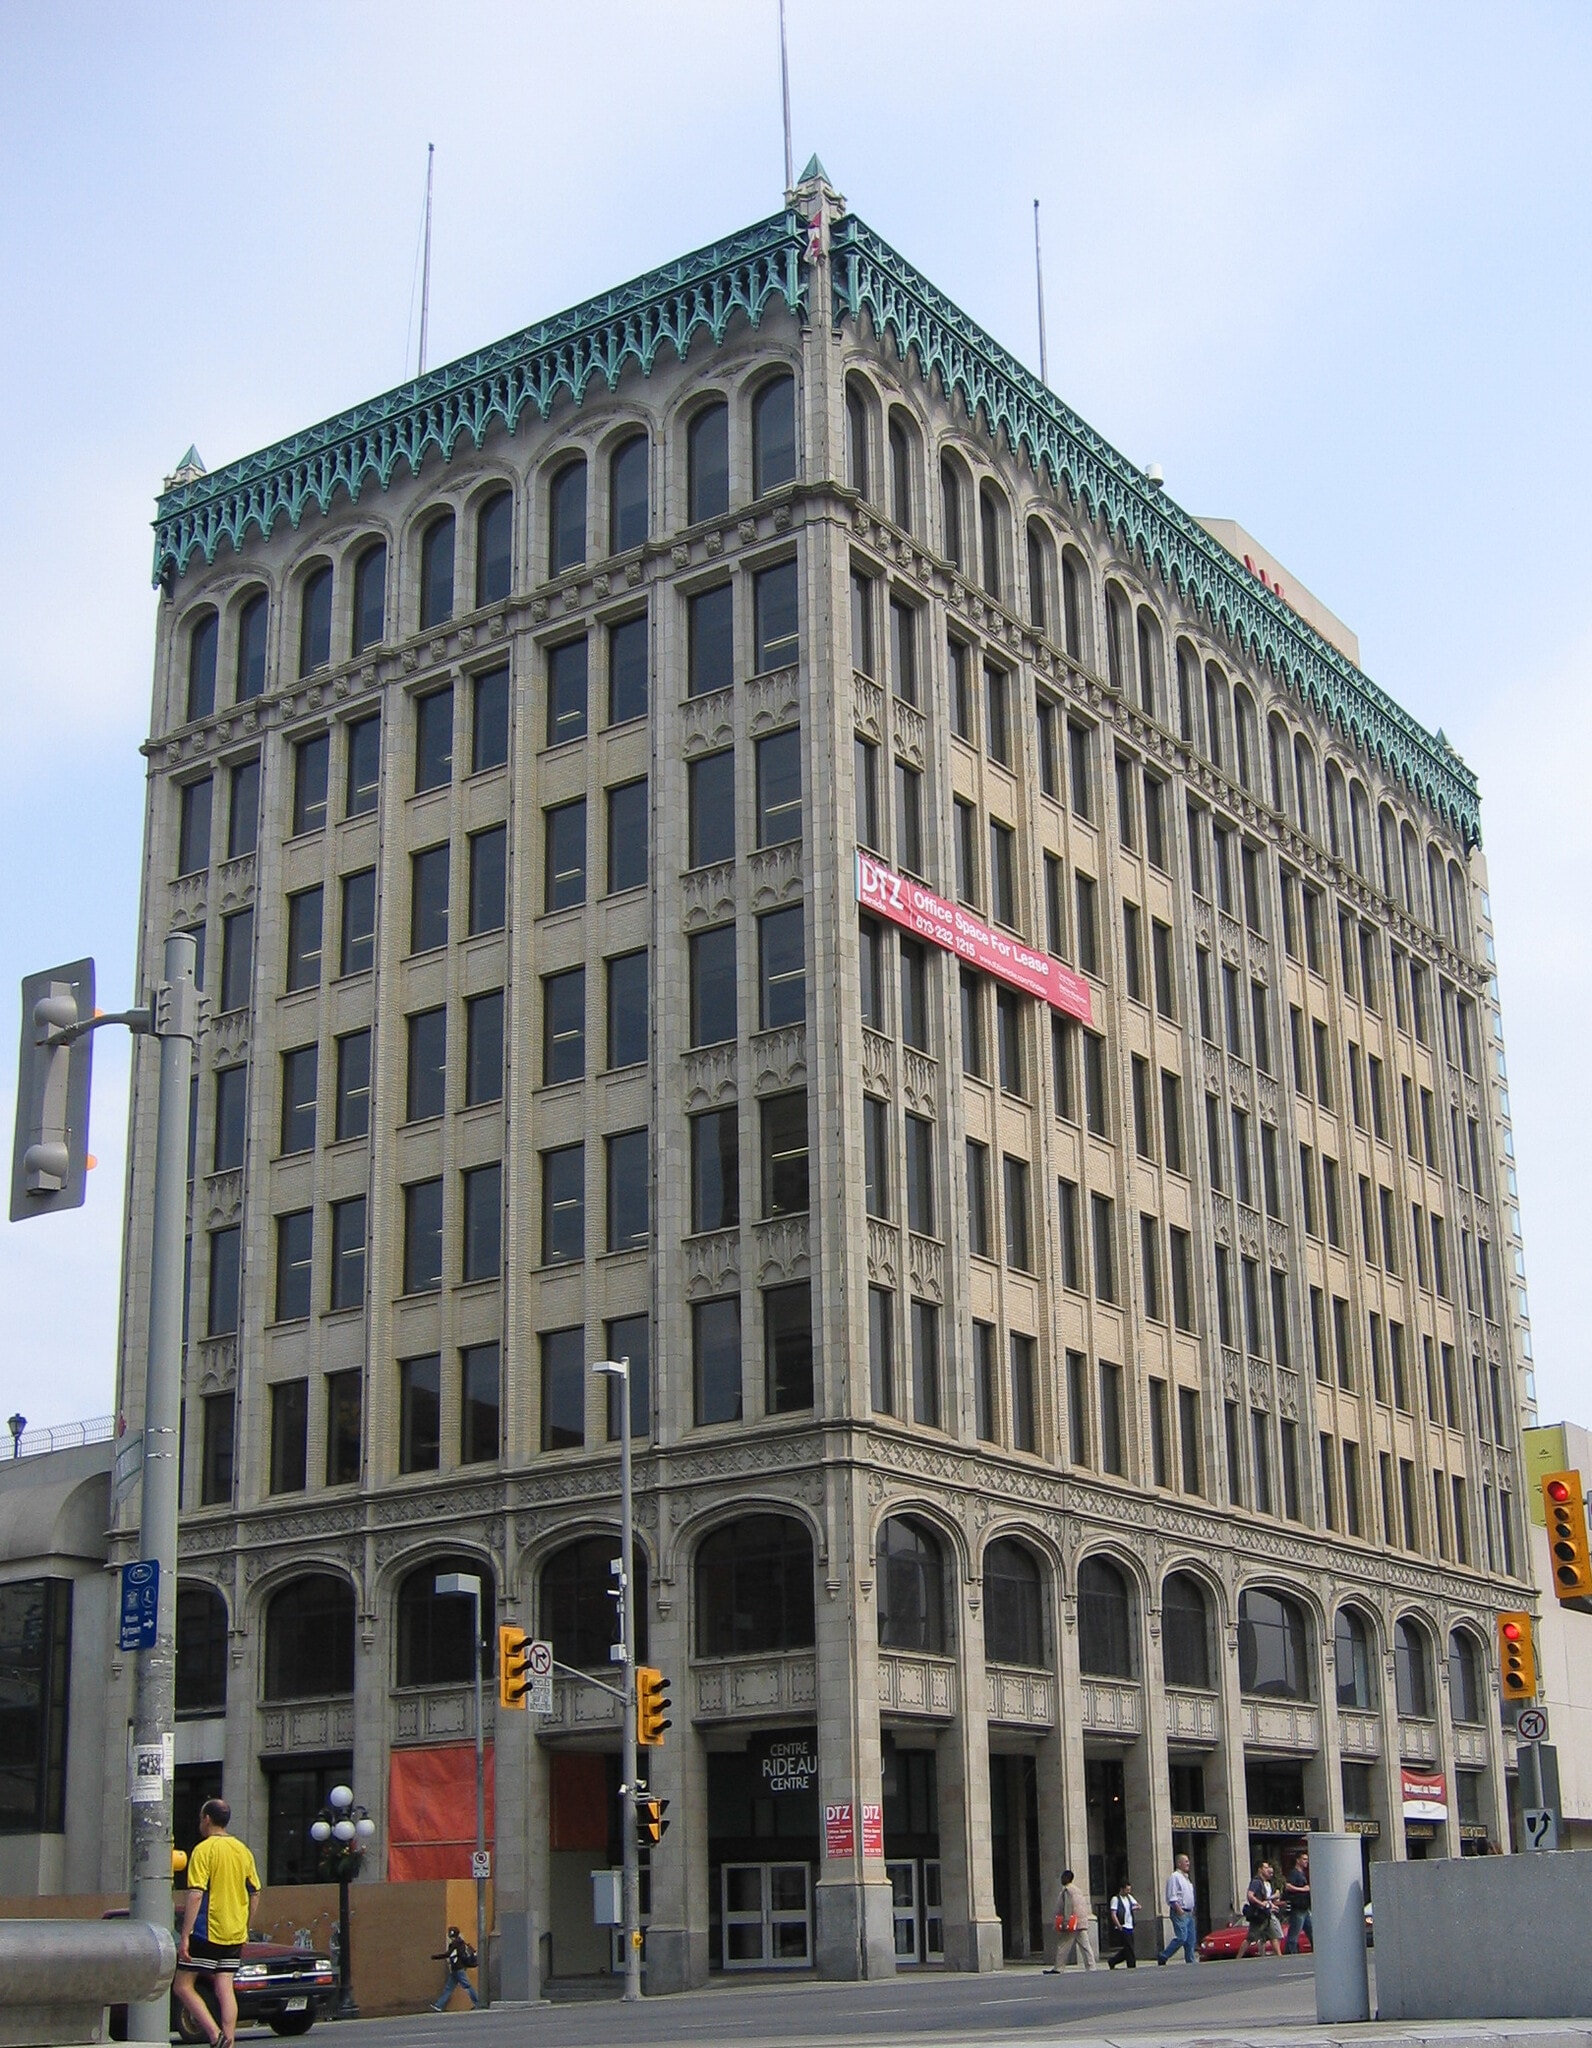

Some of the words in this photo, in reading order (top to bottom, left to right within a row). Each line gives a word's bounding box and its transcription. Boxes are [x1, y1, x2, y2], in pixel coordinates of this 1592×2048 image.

[862, 858, 904, 911] DTZ
[914, 891, 953, 924] Office
[955, 912, 989, 945] Space
[990, 934, 1010, 957] For
[1012, 945, 1049, 975] Lease
[955, 936, 976, 957] 1215
[770, 1742, 808, 1756] CENTRE
[762, 1756, 818, 1777] RIDEAU
[770, 1776, 809, 1791] CENTRE
[826, 1805, 850, 1820] DTZ
[863, 1805, 880, 1820] DTZ
[1287, 1819, 1311, 1831] CASTLE
